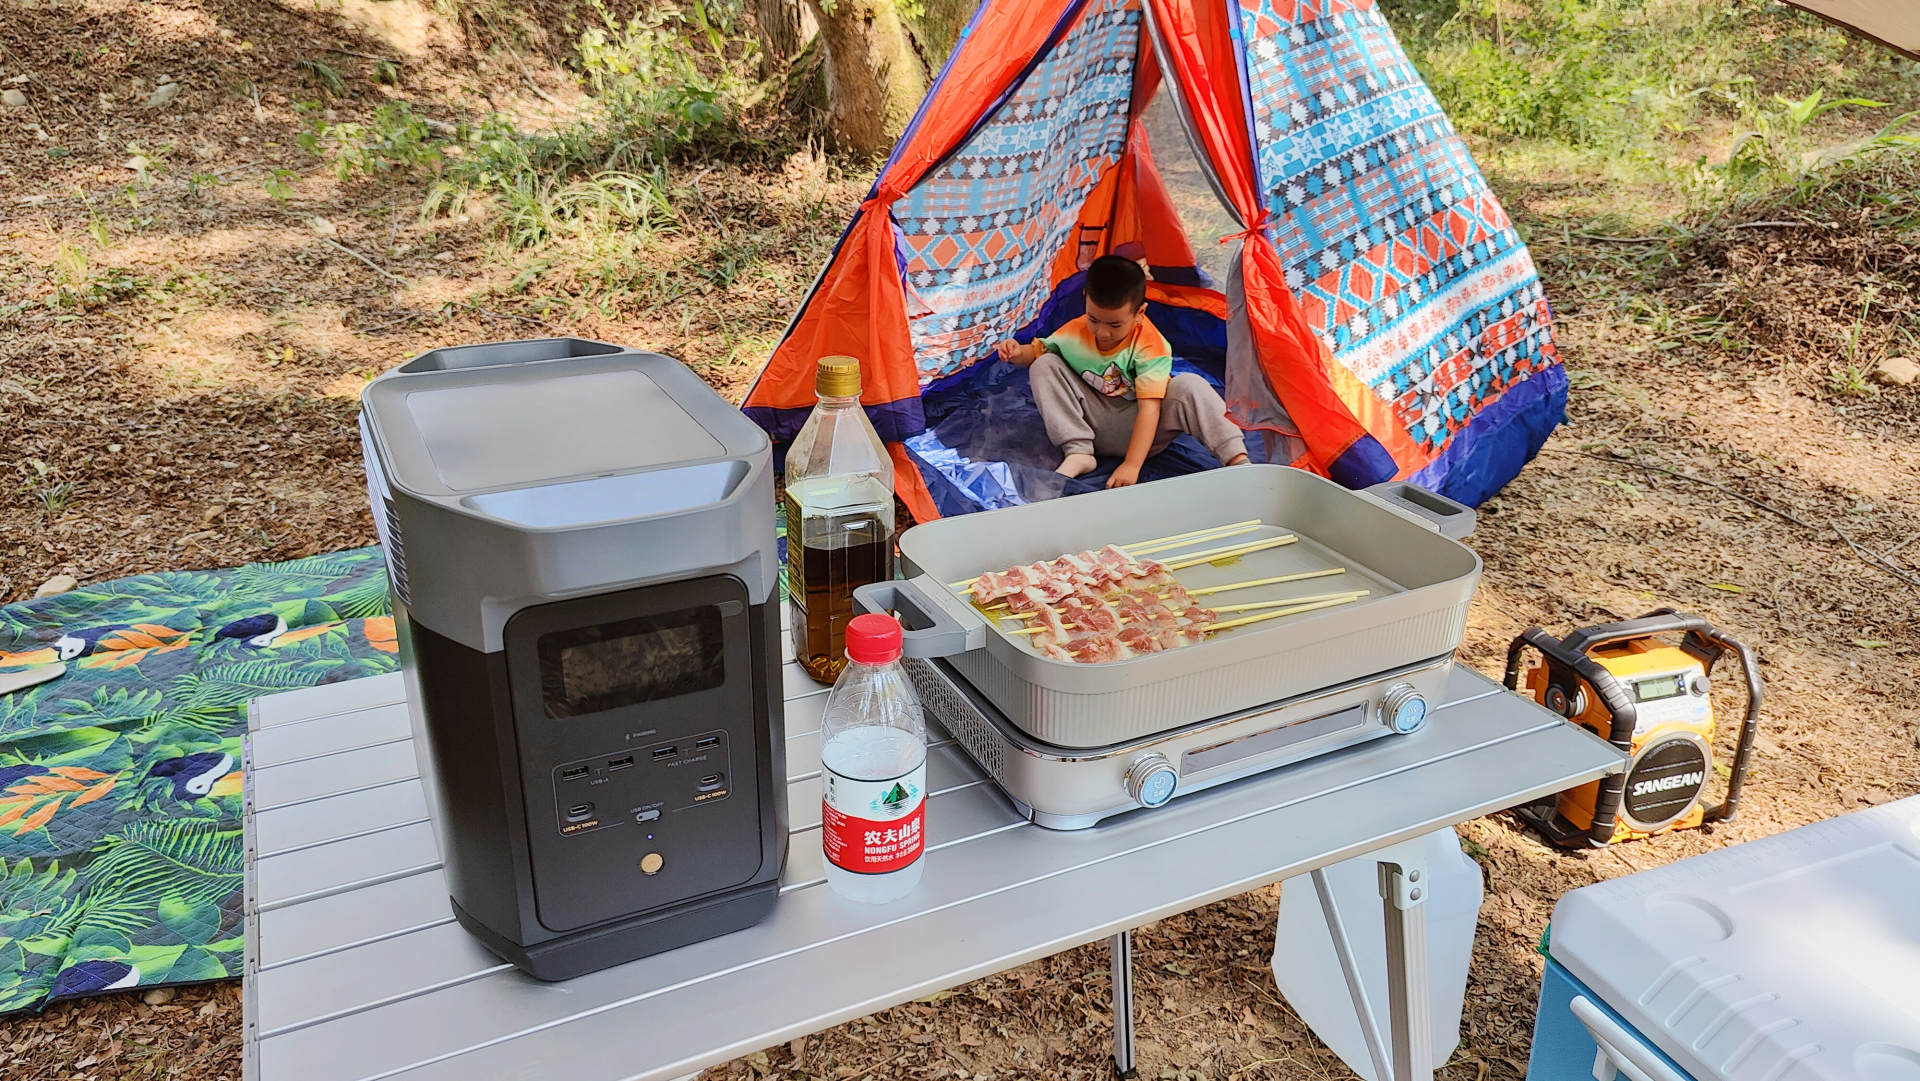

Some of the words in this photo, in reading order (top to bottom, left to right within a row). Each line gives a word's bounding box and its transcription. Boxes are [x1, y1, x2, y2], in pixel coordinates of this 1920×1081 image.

[1632, 771, 1703, 797] SANGEAN
[563, 823, 581, 833] USB-C
[864, 816, 920, 846] 农夫山泉
[864, 844, 897, 855] NONGFU
